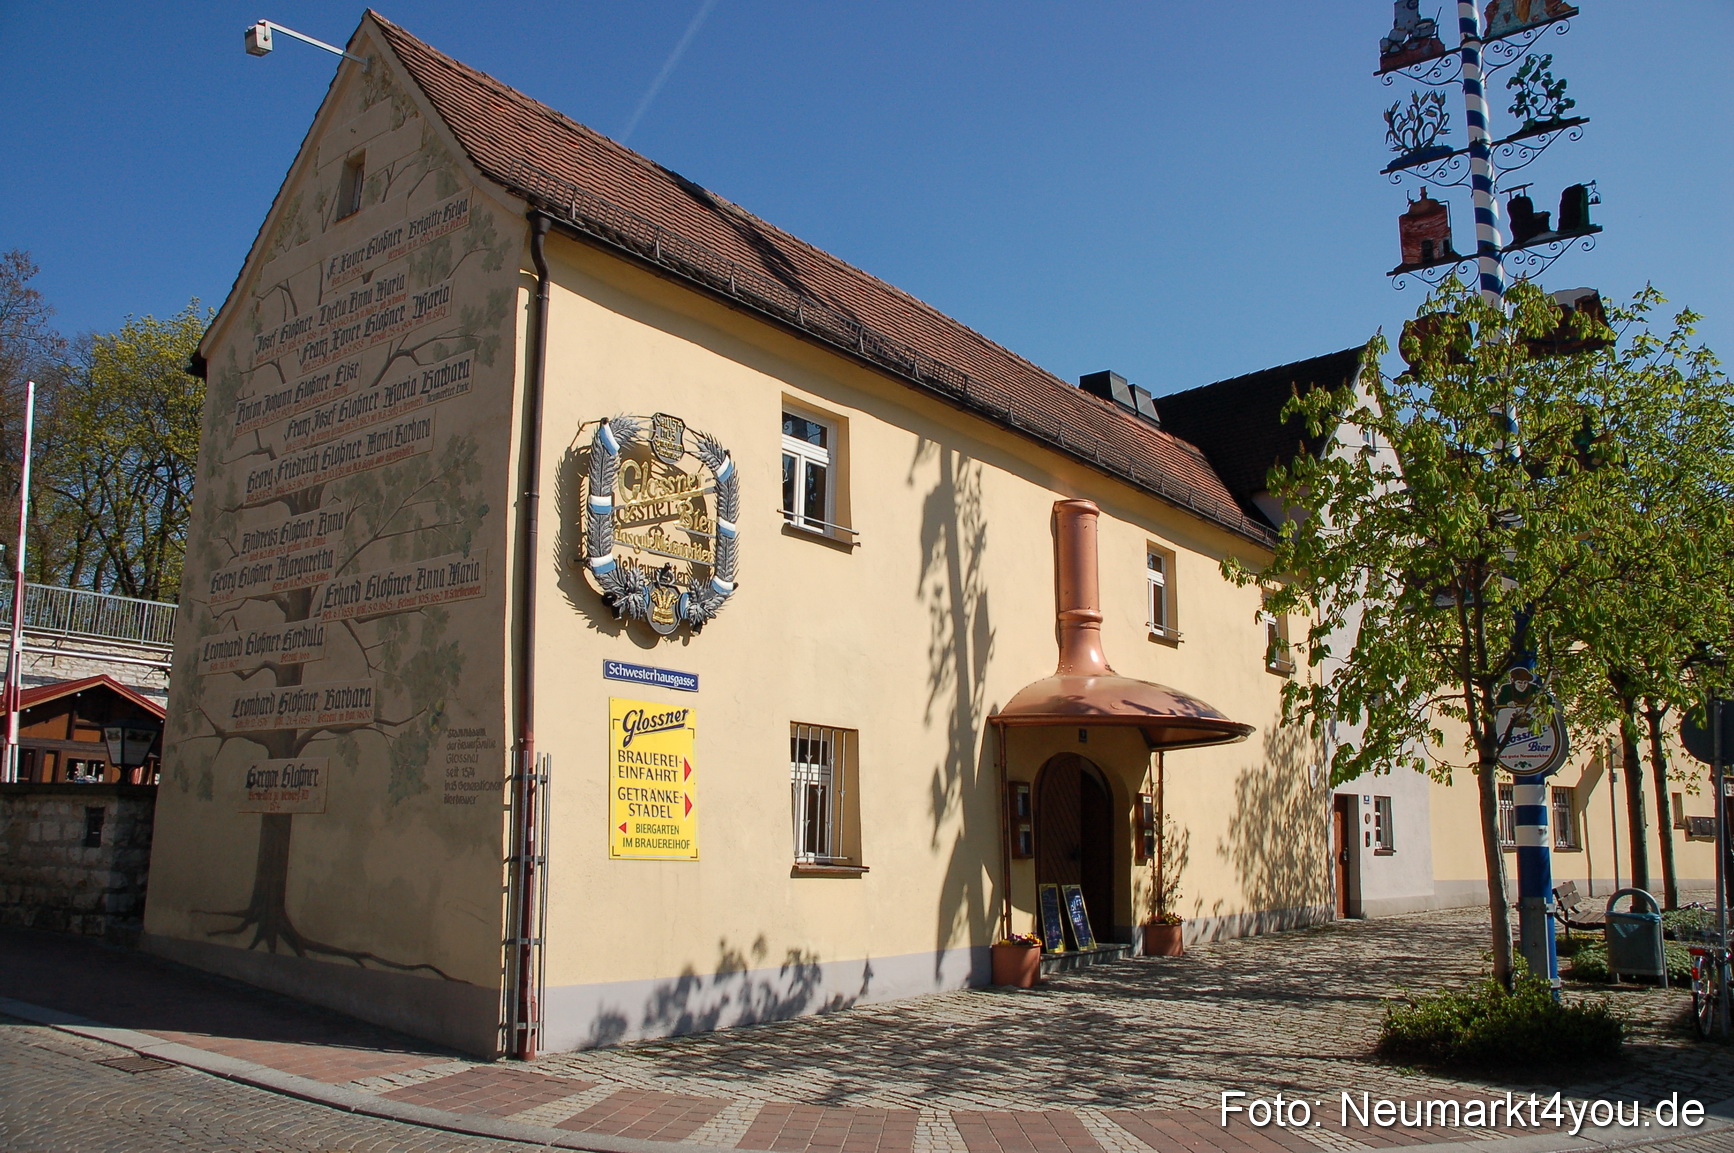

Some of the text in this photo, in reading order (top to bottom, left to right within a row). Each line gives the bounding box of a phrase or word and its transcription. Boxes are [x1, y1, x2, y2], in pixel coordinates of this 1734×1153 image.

[408, 210, 442, 240] Brigitte
[443, 199, 468, 224] Helga
[255, 329, 278, 354] Josef
[348, 289, 373, 314] Anna
[375, 273, 406, 302] Maria
[300, 337, 328, 366] Franz
[330, 324, 361, 352] Xaver
[363, 303, 406, 337] Gloßner
[412, 283, 450, 319] Maria
[235, 399, 262, 427] Anton
[263, 389, 293, 414] Johann
[333, 361, 360, 387] Elise
[283, 415, 311, 442] Franz
[311, 405, 337, 433] Josef
[337, 392, 379, 423] Gloßner
[383, 375, 417, 408] Maria
[420, 358, 470, 395] Barbara
[246, 467, 274, 494] Georg
[274, 450, 320, 484] Friedrich
[321, 439, 362, 471] Gloßner
[365, 426, 394, 457] Maria
[393, 417, 431, 448] Barbara
[618, 459, 704, 506] Glossner
[241, 528, 278, 555] Andreas
[317, 512, 344, 537] Anna
[678, 497, 714, 536] Bier
[613, 528, 634, 546] das
[633, 533, 654, 555] gute
[210, 571, 237, 596] Georg
[276, 549, 334, 581] Margaretha
[323, 578, 362, 609] Erhard
[364, 571, 412, 602] Gloßner
[415, 566, 445, 591] Anna
[448, 558, 480, 587] Maria
[202, 635, 244, 662] Leonhard
[281, 624, 324, 651] Kordula
[609, 662, 695, 687] Schwesterhausgasse
[231, 686, 372, 719] Leonhard Gloßner Barbara
[622, 708, 689, 748] Glossner
[1529, 742, 1551, 752] Bier
[462, 767, 476, 778] 1574
[618, 749, 683, 768] BRAUEREI-
[618, 765, 679, 783] EINFAHRT
[245, 763, 320, 793] Gregor Gloßner
[618, 786, 683, 804] GETRÄNKE-
[629, 802, 673, 819] STADEL
[636, 823, 680, 835] BIERGARTEN
[623, 838, 691, 850] IM BRAUEREIHOF
